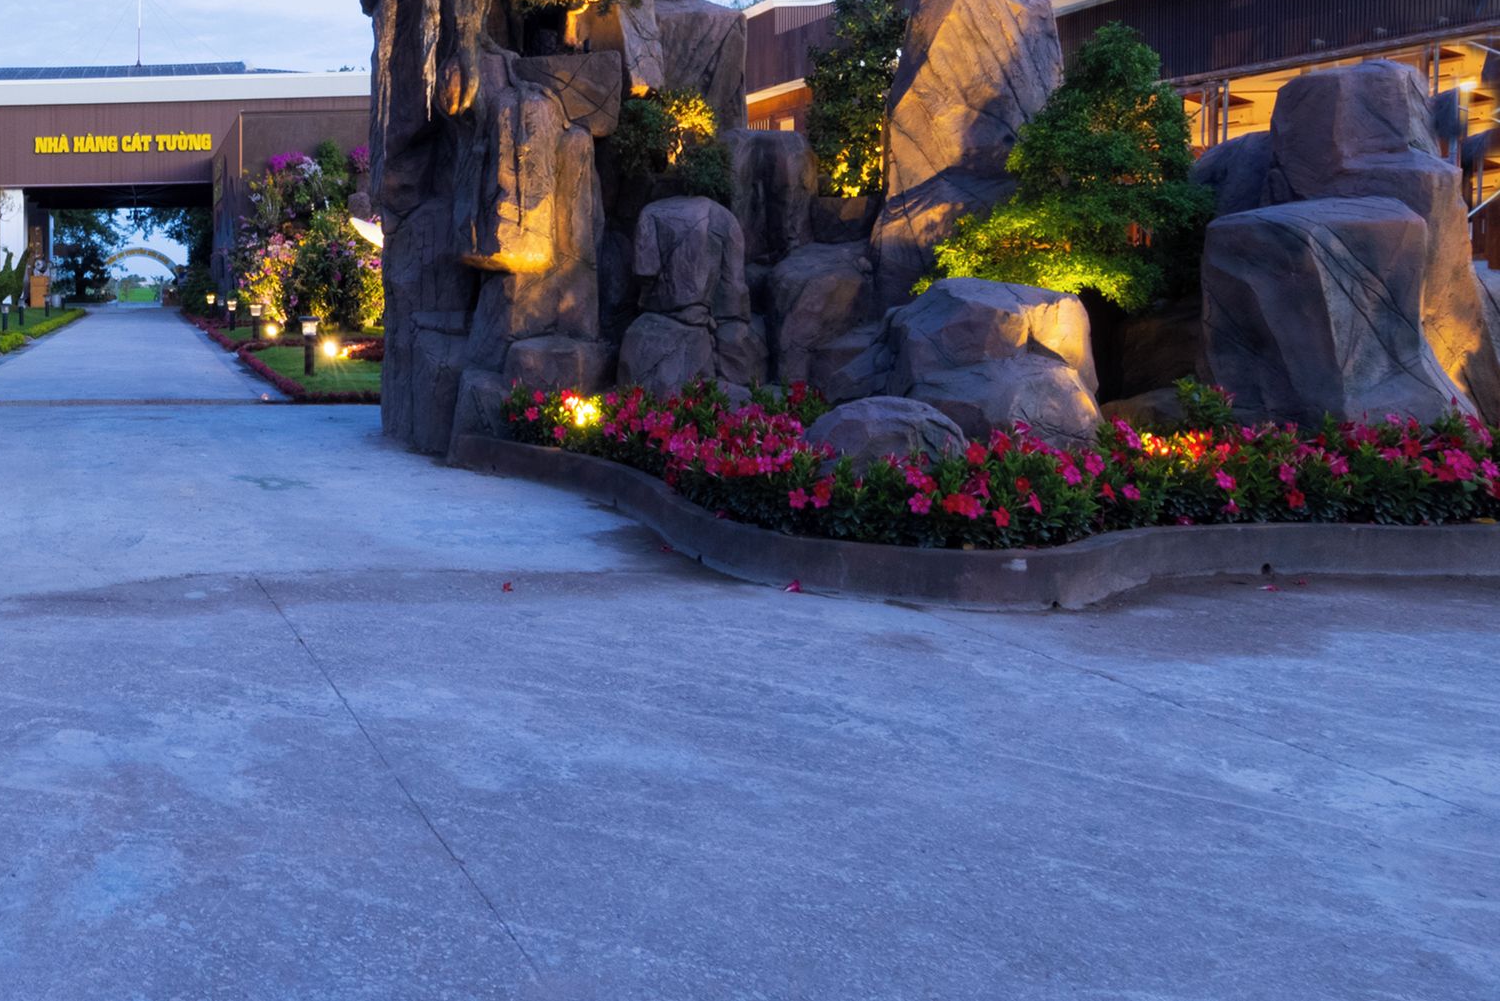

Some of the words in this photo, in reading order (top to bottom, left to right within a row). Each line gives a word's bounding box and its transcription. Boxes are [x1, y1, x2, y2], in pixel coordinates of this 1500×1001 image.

[34, 133, 70, 153] NHÀ
[73, 132, 119, 153] HÀNG
[121, 132, 152, 152] CÁT
